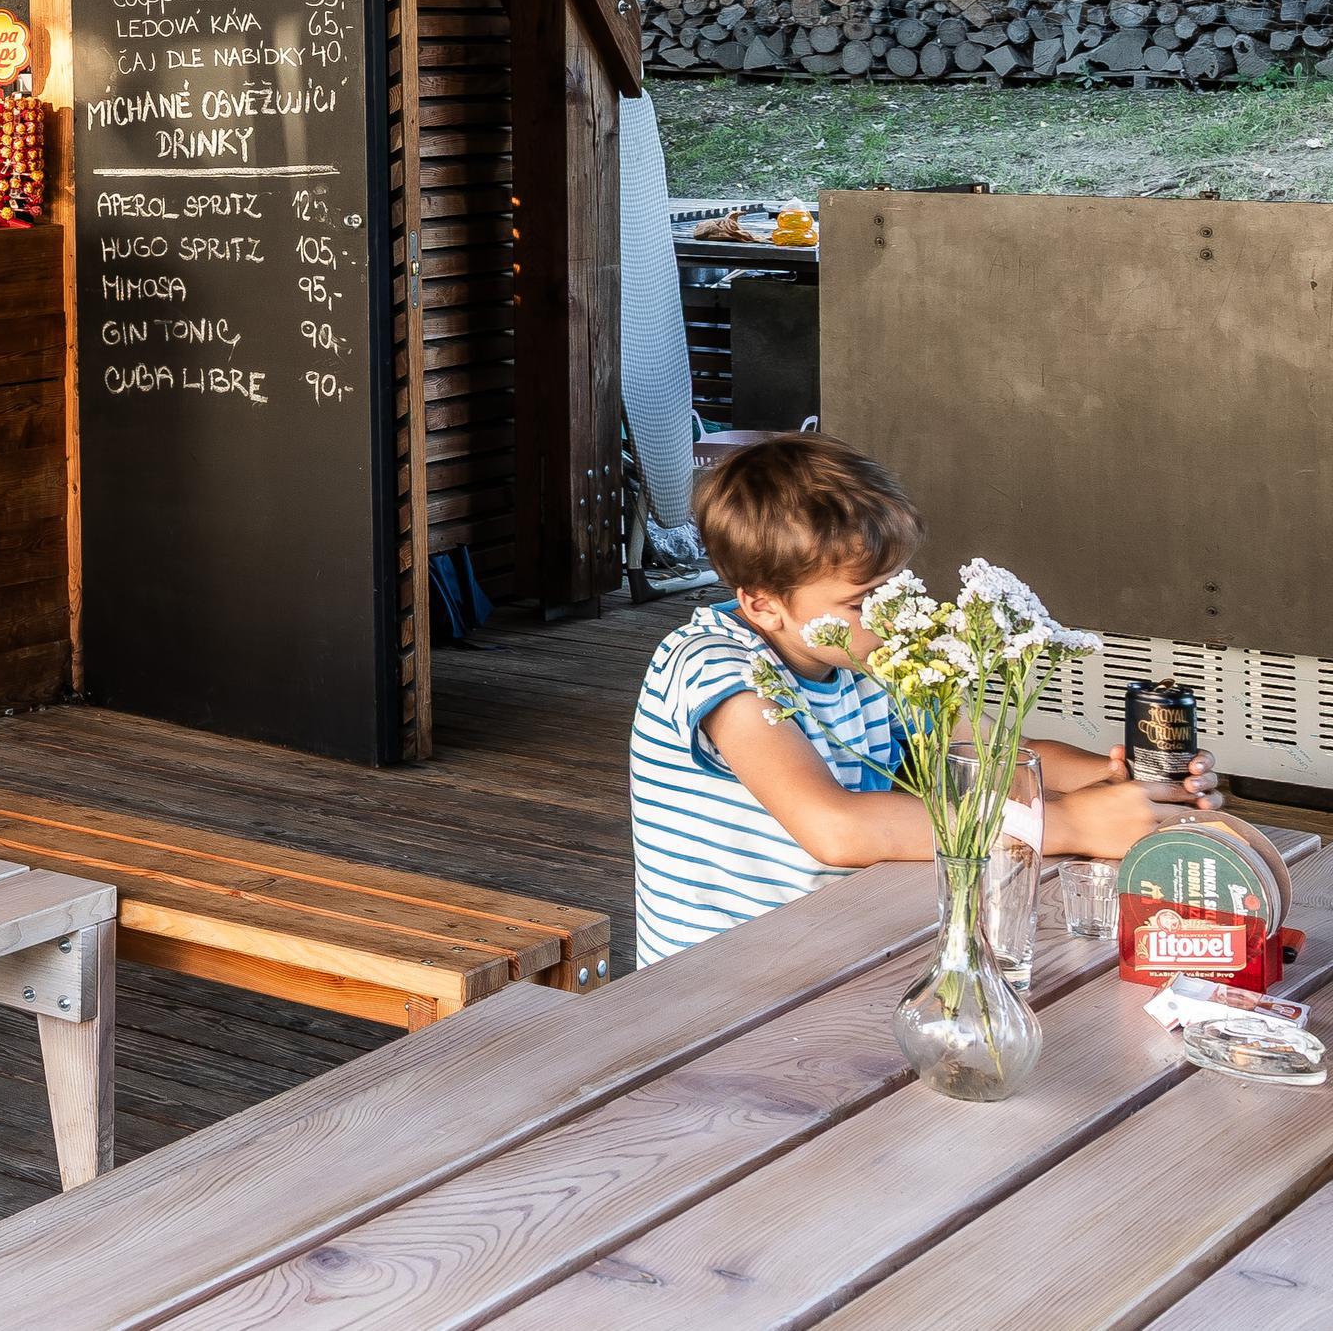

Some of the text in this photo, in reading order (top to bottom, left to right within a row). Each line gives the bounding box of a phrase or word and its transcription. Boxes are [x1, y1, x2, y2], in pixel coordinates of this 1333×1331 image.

[117, 8, 201, 38] LEDOVÁ
[211, 7, 262, 34] KÁVA
[117, 49, 156, 75] ČAJ
[167, 48, 205, 69] DLE
[214, 40, 306, 68] NABÍDKY
[87, 79, 193, 131] MÍCHANÉ
[155, 127, 254, 163] DRINKY
[97, 192, 180, 219] APEROL
[183, 192, 262, 219] SPRITZ
[101, 236, 168, 263] HUGO
[178, 236, 264, 264] SPRITZ
[102, 274, 187, 302] MIMOSA
[102, 320, 148, 346] GIN
[154, 318, 241, 350] TONIC
[105, 362, 174, 394] CUBA
[183, 367, 269, 404] LIBRE
[1148, 703, 1189, 726] ROYAL
[1138, 720, 1190, 743] CROWN
[1187, 861, 1203, 898] DOBRÁ
[1203, 857, 1220, 899] MOKRÁ
[1148, 931, 1235, 963] Litovel
